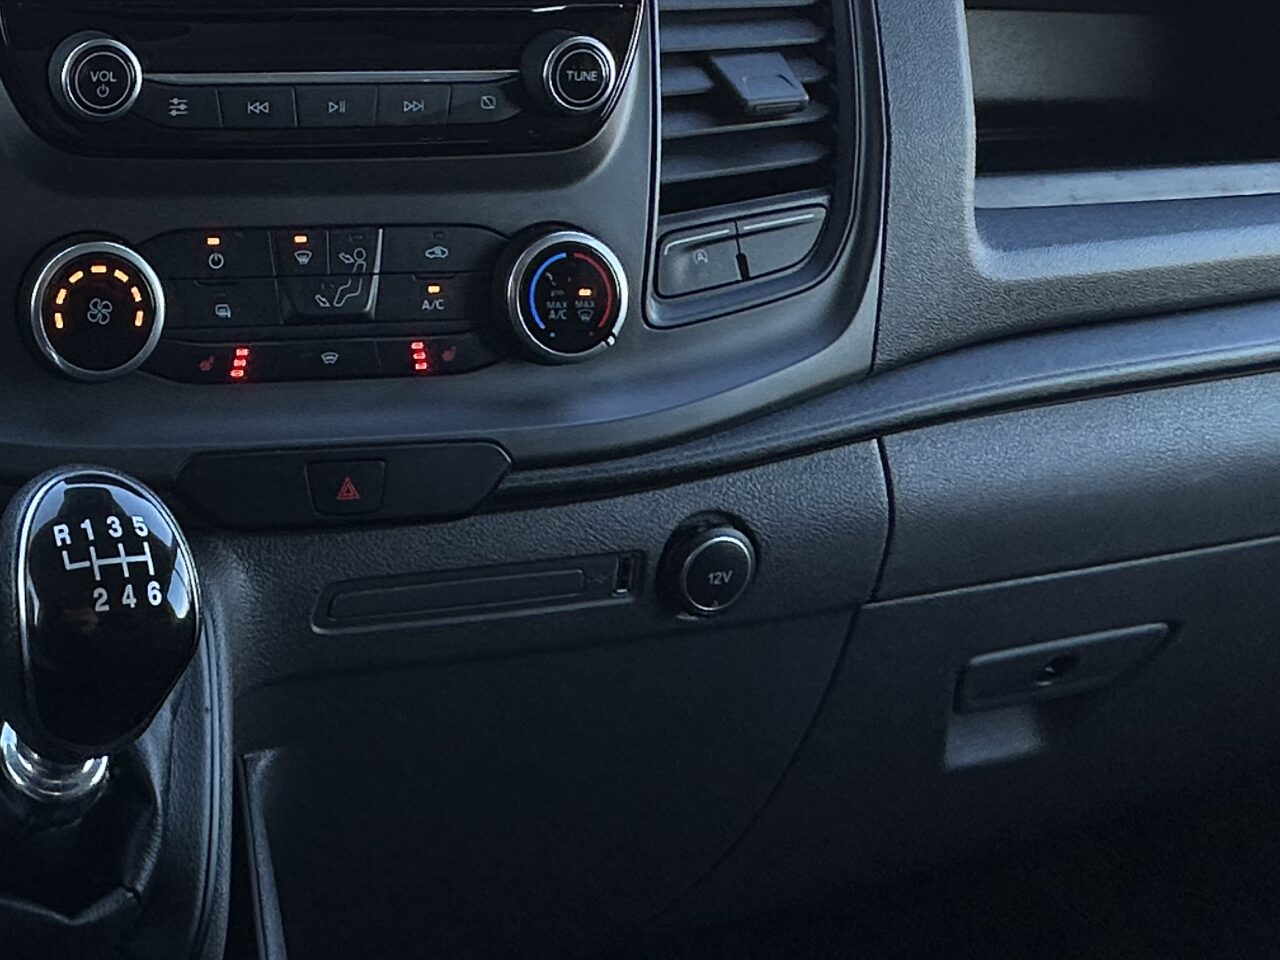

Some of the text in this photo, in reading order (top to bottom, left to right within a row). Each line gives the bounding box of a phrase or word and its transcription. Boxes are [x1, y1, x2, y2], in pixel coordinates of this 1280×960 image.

[89, 70, 118, 83] VOL
[566, 70, 598, 82] TUNE
[421, 298, 445, 310] A/C
[547, 300, 568, 309] MAX
[575, 300, 596, 309] MAX
[549, 309, 568, 320] A/C
[53, 515, 149, 547] R 1 3 5
[707, 570, 734, 585] 12V
[93, 580, 163, 612] 2 4 6
